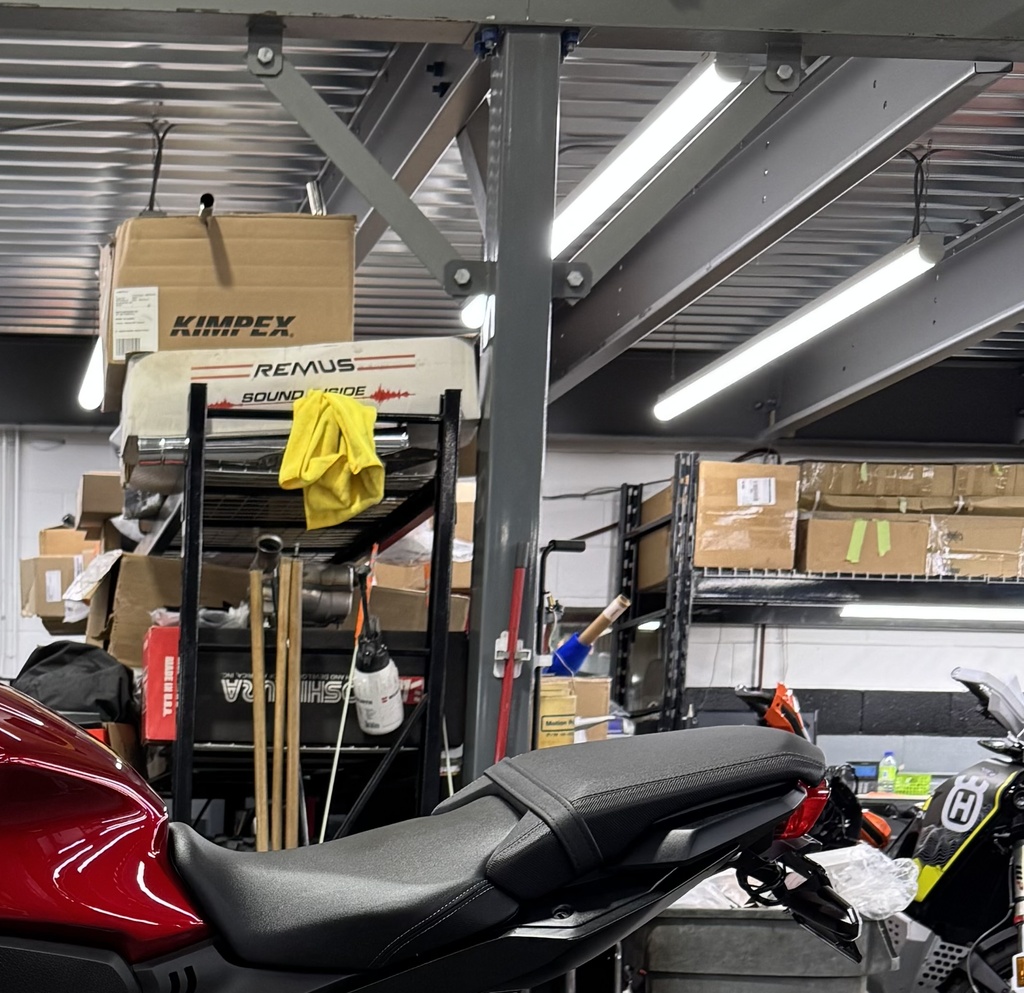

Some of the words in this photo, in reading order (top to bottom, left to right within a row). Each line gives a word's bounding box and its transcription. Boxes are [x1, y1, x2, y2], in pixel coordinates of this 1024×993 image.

[170, 316, 296, 337] KIMPEX
[253, 358, 355, 380] REMUS
[241, 390, 304, 403] SOUND
